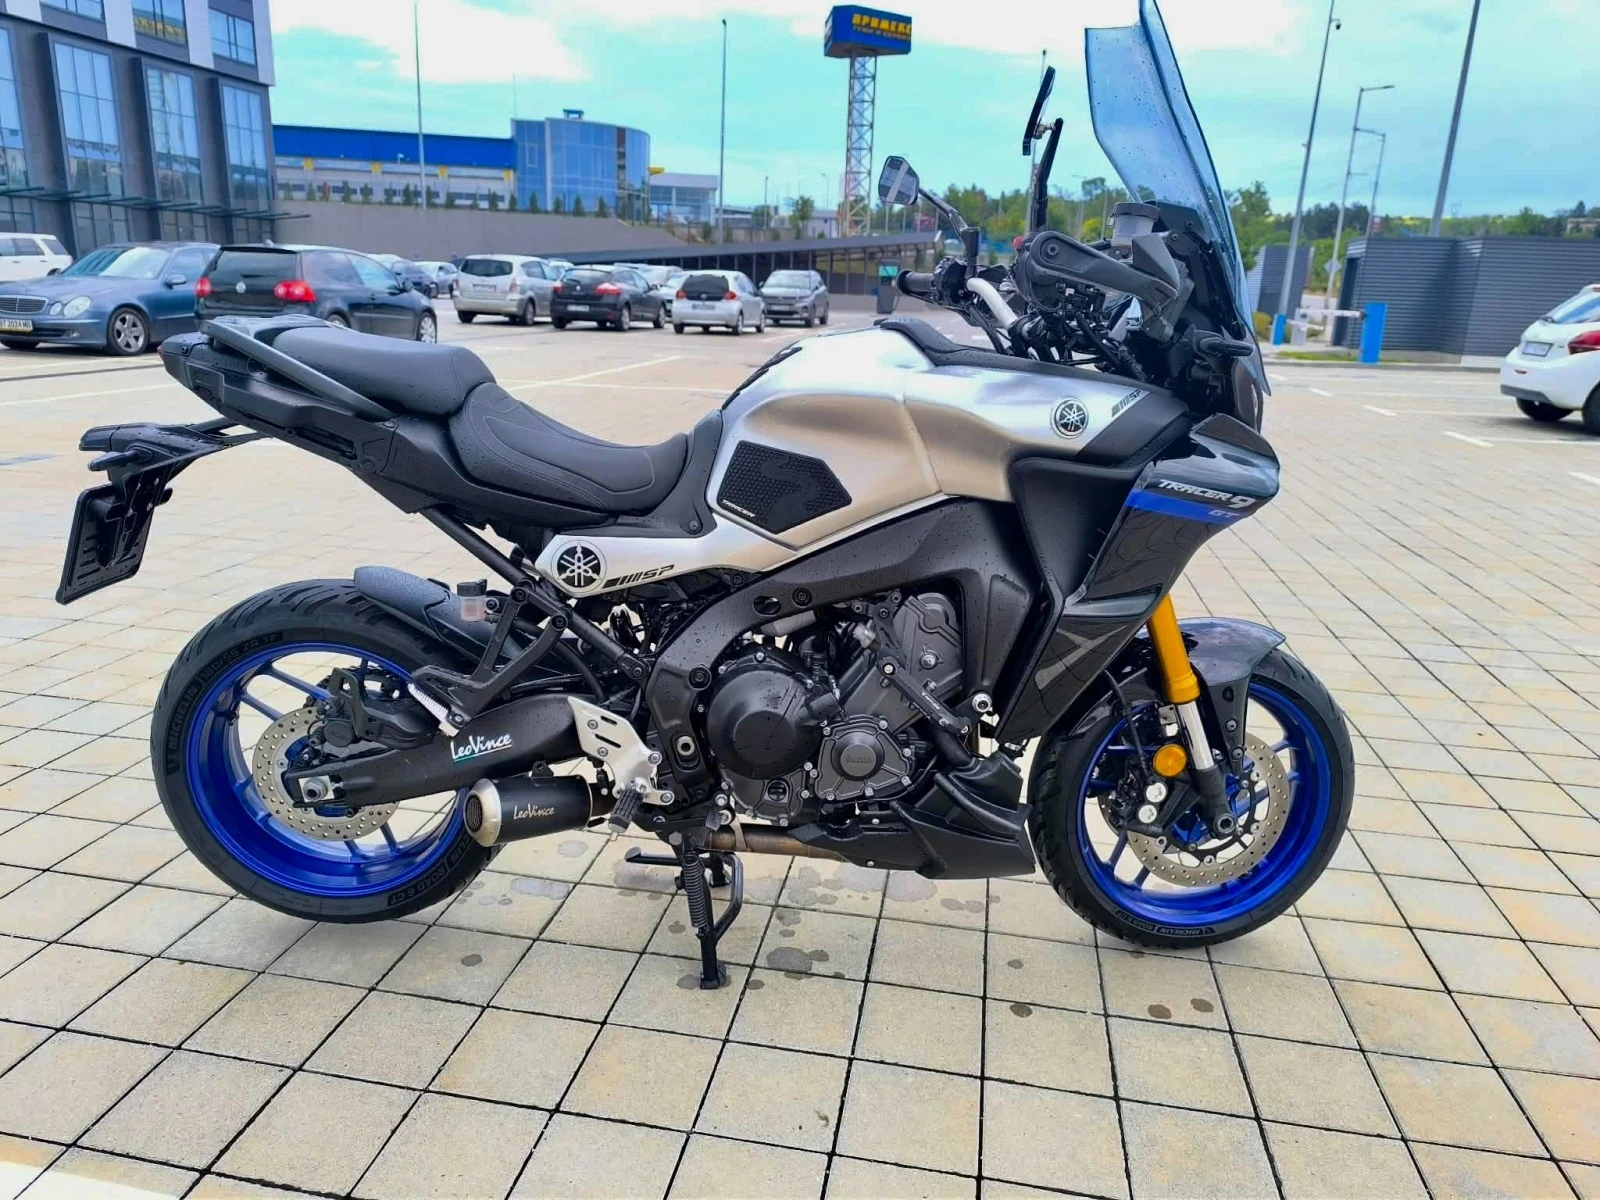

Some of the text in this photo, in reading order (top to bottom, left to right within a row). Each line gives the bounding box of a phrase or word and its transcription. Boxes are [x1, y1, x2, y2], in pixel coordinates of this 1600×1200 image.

[1158, 479, 1256, 509] TRACER 9
[1207, 509, 1241, 518] GT
[641, 564, 675, 580] SP
[168, 682, 198, 748] MICHELIN
[201, 651, 239, 684] 180/55
[450, 734, 513, 760] LeoVince
[513, 803, 555, 820] LeoVince
[419, 869, 446, 890] ROAD
[1132, 920, 1154, 931] ROAD
[1159, 926, 1200, 936] MICHELIN
